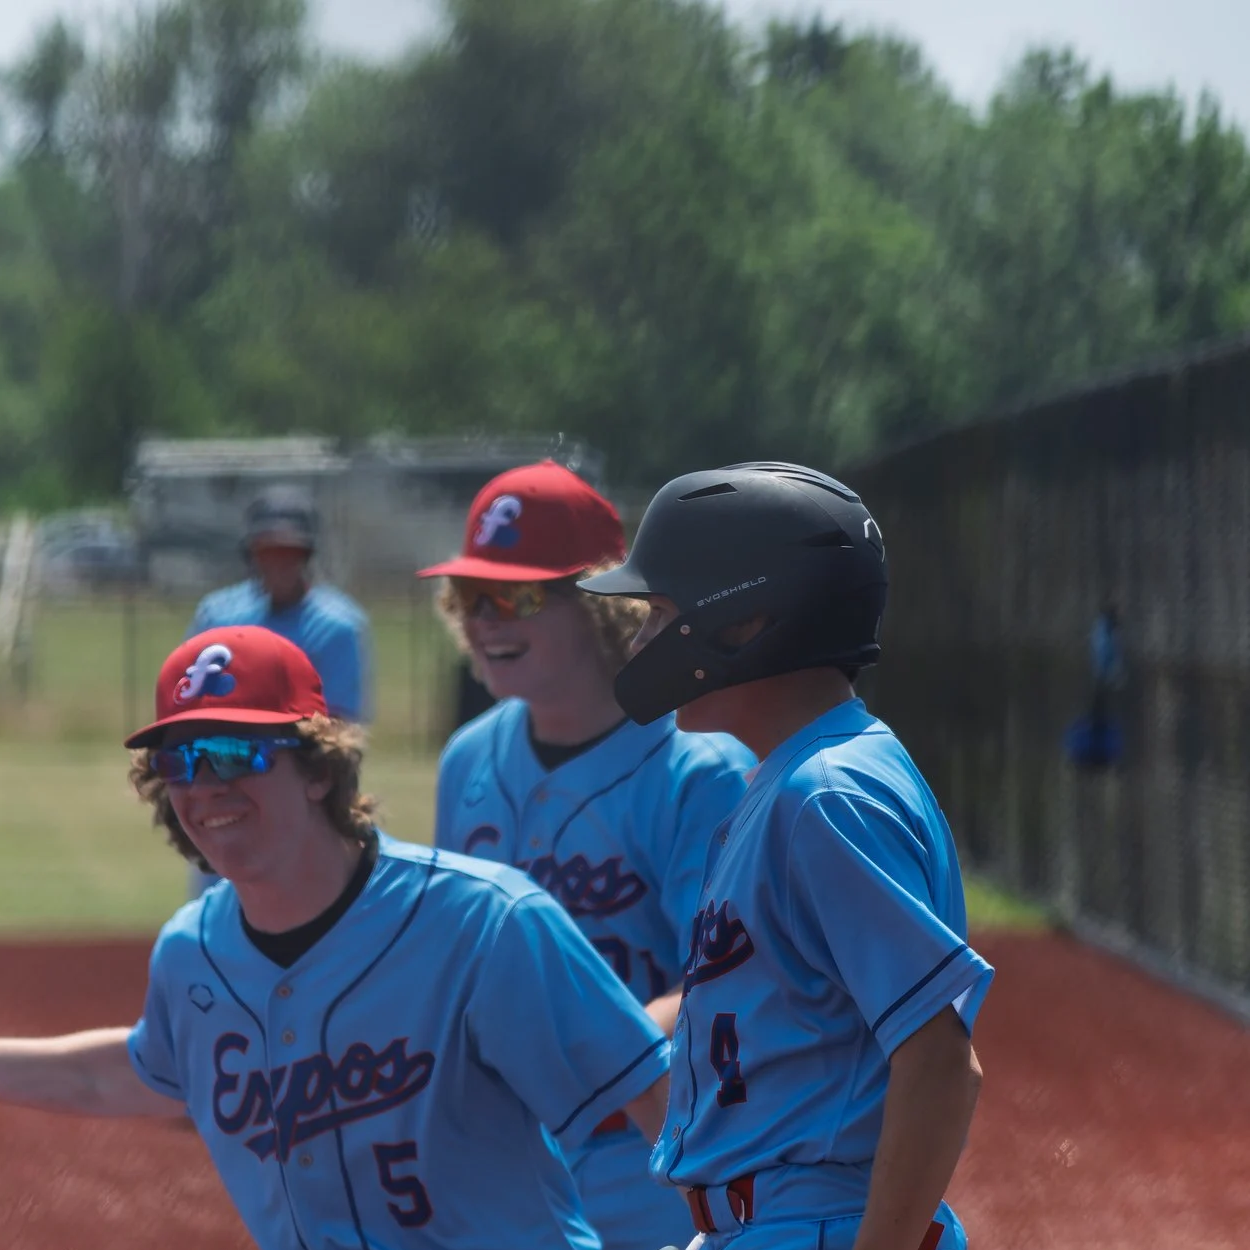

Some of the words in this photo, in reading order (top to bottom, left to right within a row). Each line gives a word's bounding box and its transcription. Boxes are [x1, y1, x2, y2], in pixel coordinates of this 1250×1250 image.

[696, 576, 767, 607] EVOSHIELD
[211, 1032, 436, 1165] Expos
[709, 1012, 748, 1109] 4
[372, 1140, 433, 1228] 5
